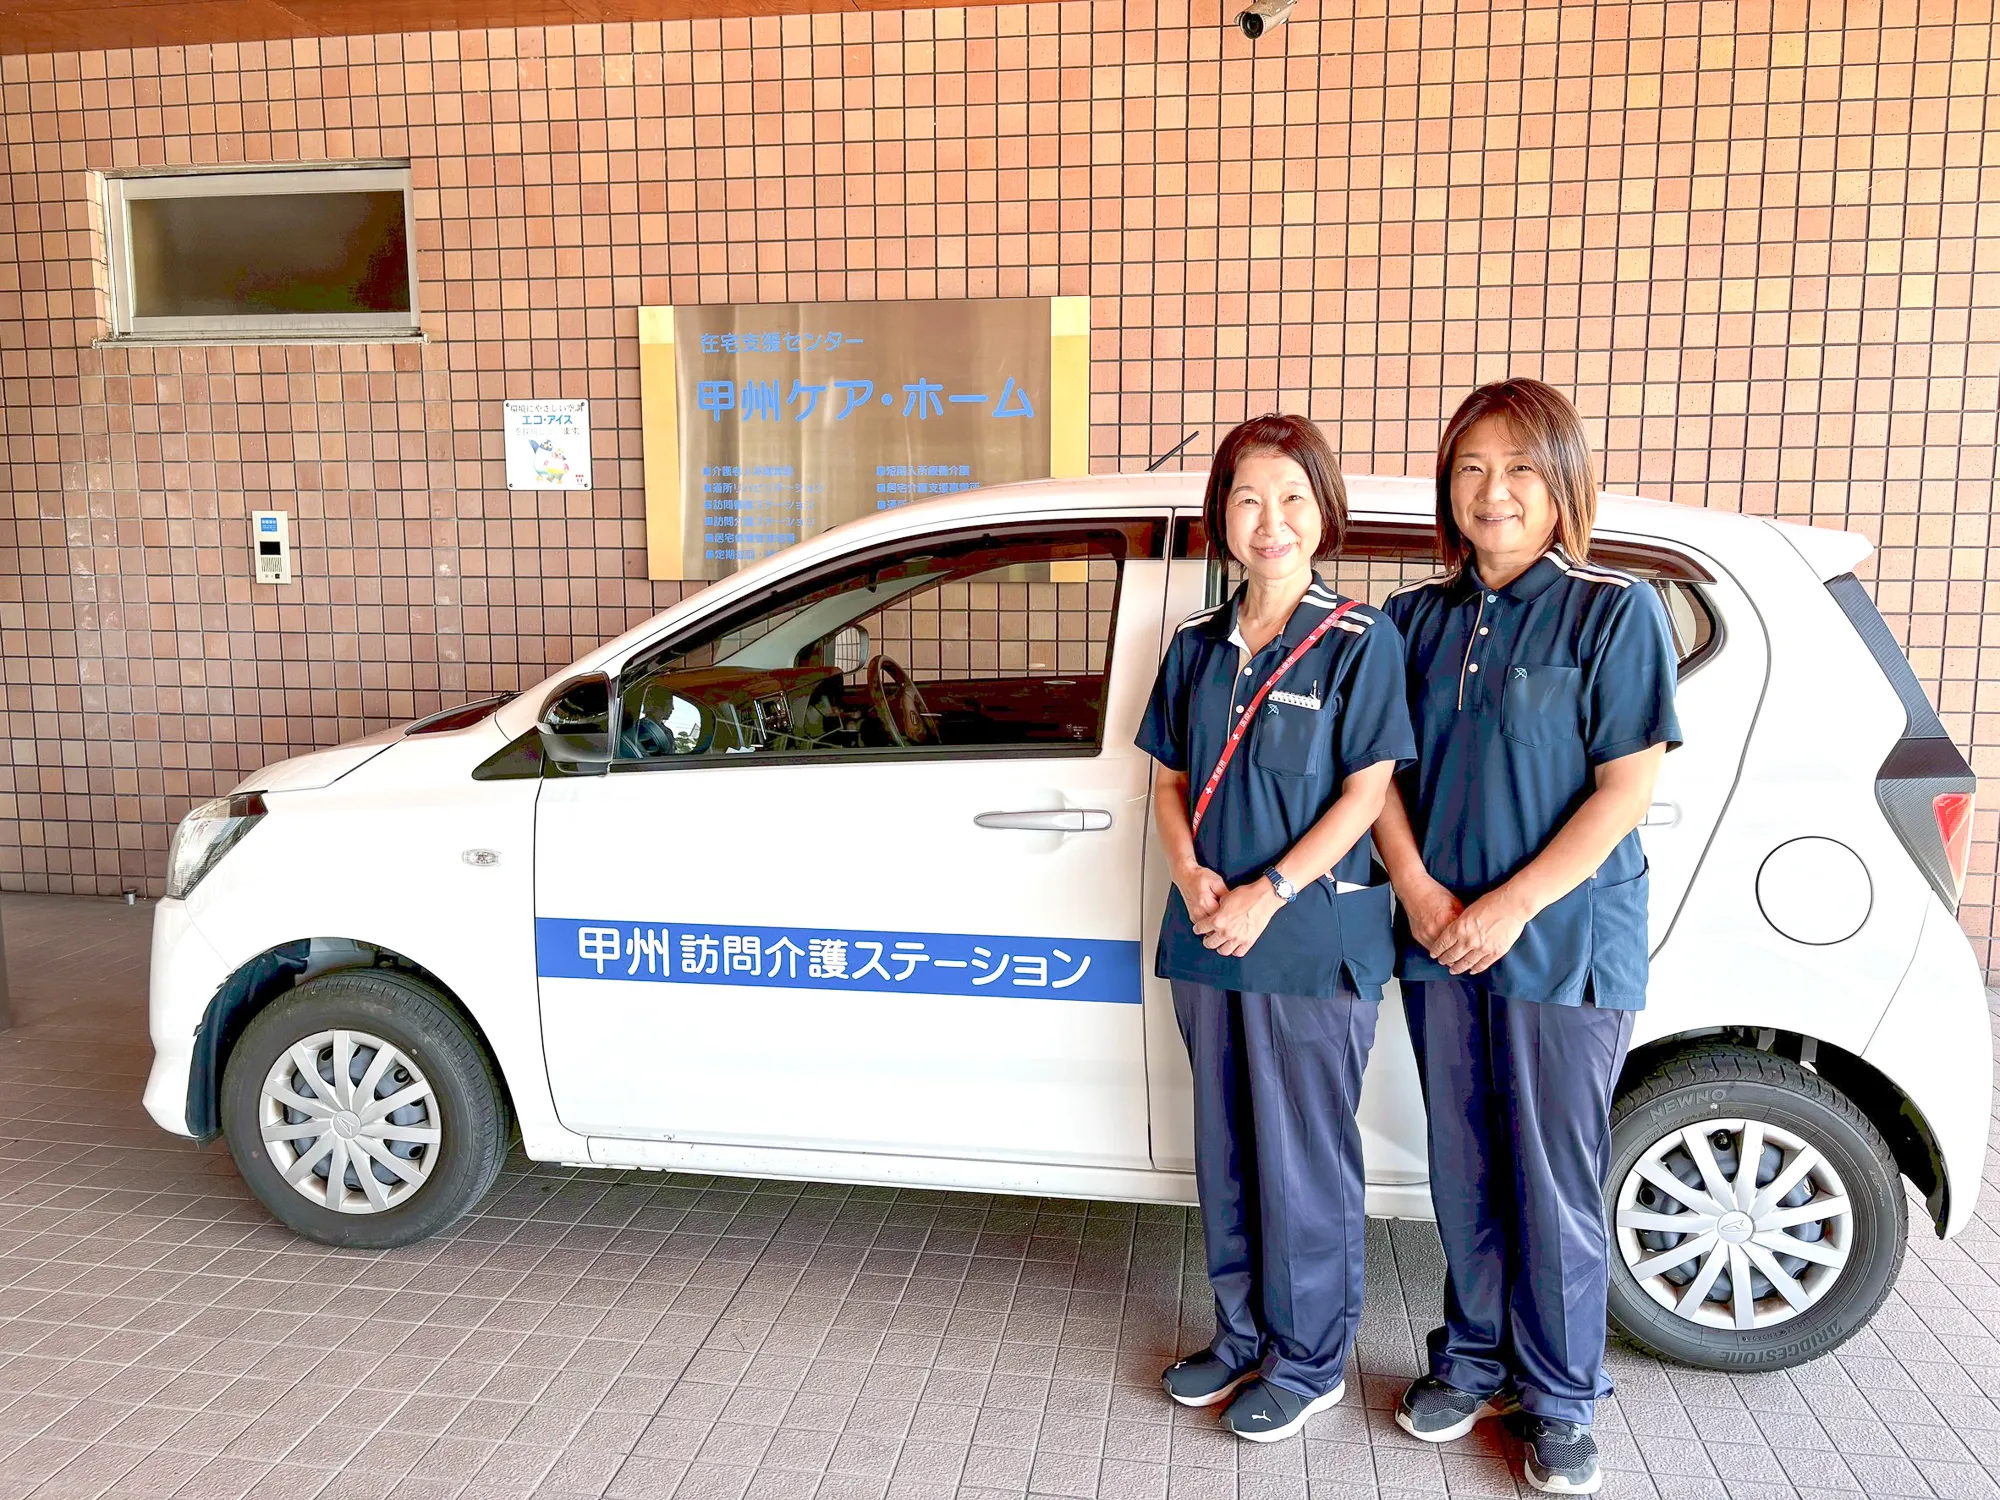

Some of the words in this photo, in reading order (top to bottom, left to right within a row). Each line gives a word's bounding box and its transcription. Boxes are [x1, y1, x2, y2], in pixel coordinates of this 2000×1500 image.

[700, 331, 864, 354] 在宅支援センター
[697, 377, 1035, 422] 甲州ケア・ホーム
[522, 414, 573, 425] エコ・アイス
[1720, 1319, 1844, 1365] BRIDGESTONE
